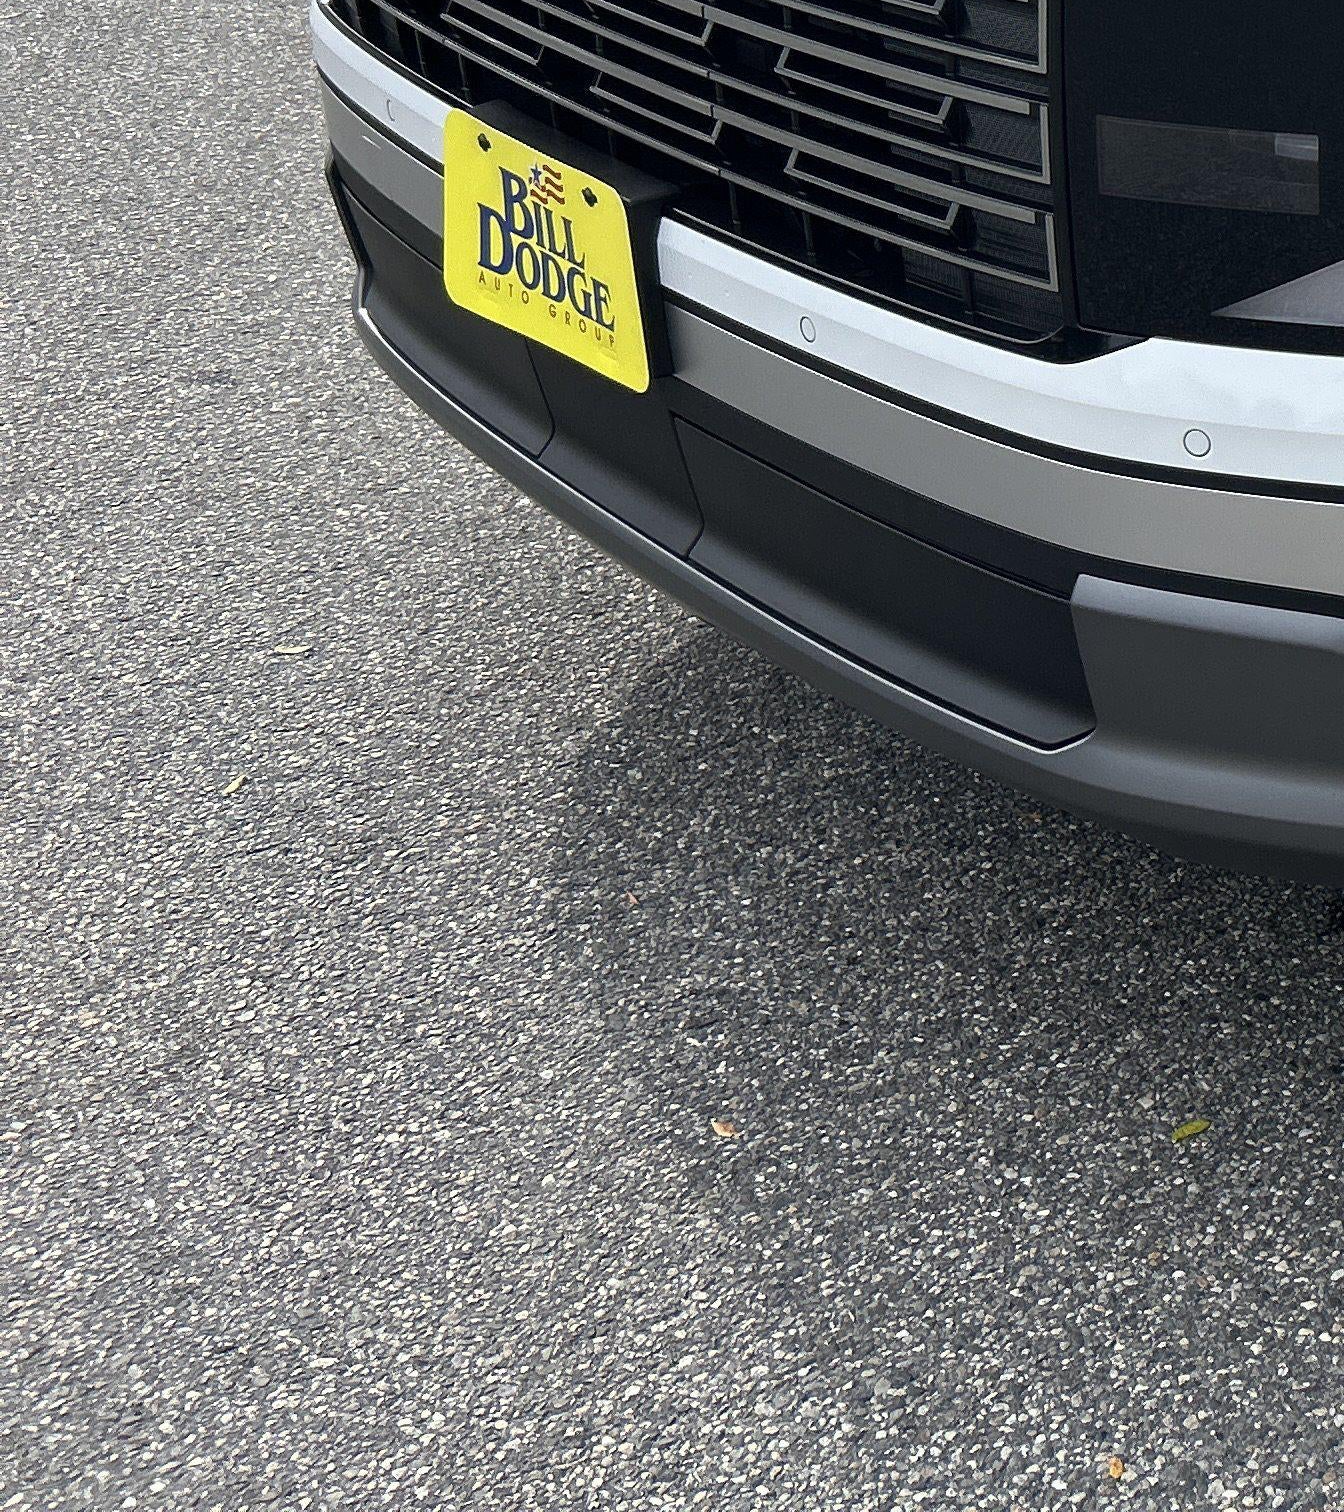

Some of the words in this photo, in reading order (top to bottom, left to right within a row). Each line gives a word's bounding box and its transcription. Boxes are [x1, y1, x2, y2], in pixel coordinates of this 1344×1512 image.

[476, 201, 616, 333] DODGE
[498, 165, 586, 270] BILL
[478, 270, 530, 305] AUTO
[549, 303, 615, 348] GROUP
